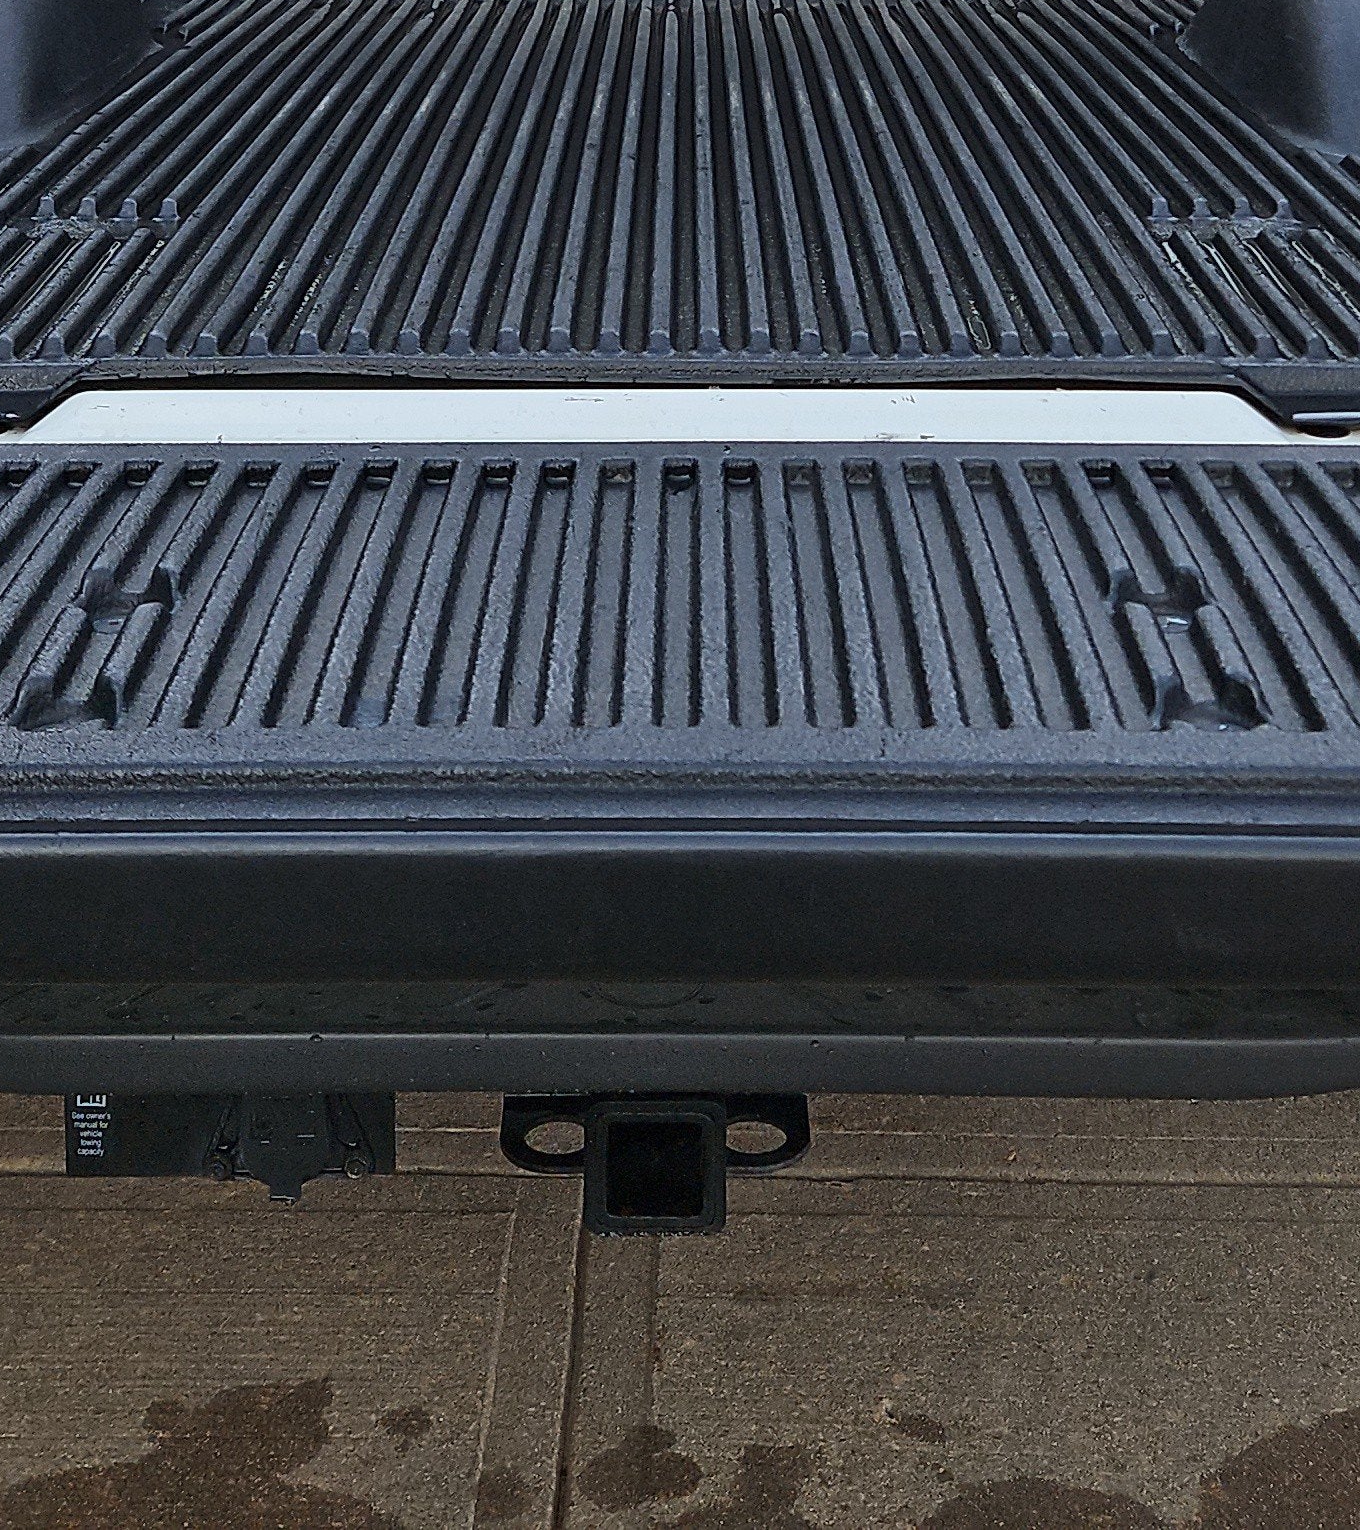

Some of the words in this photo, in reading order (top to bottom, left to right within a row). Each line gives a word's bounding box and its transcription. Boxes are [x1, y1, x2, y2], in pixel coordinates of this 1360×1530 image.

[71, 1111, 85, 1120] See
[85, 1111, 111, 1120] owner's
[73, 1121, 98, 1129] manual
[99, 1120, 109, 1129] for
[79, 1130, 103, 1138] vehicle
[80, 1139, 102, 1148] towing
[77, 1148, 104, 1157] capacity
